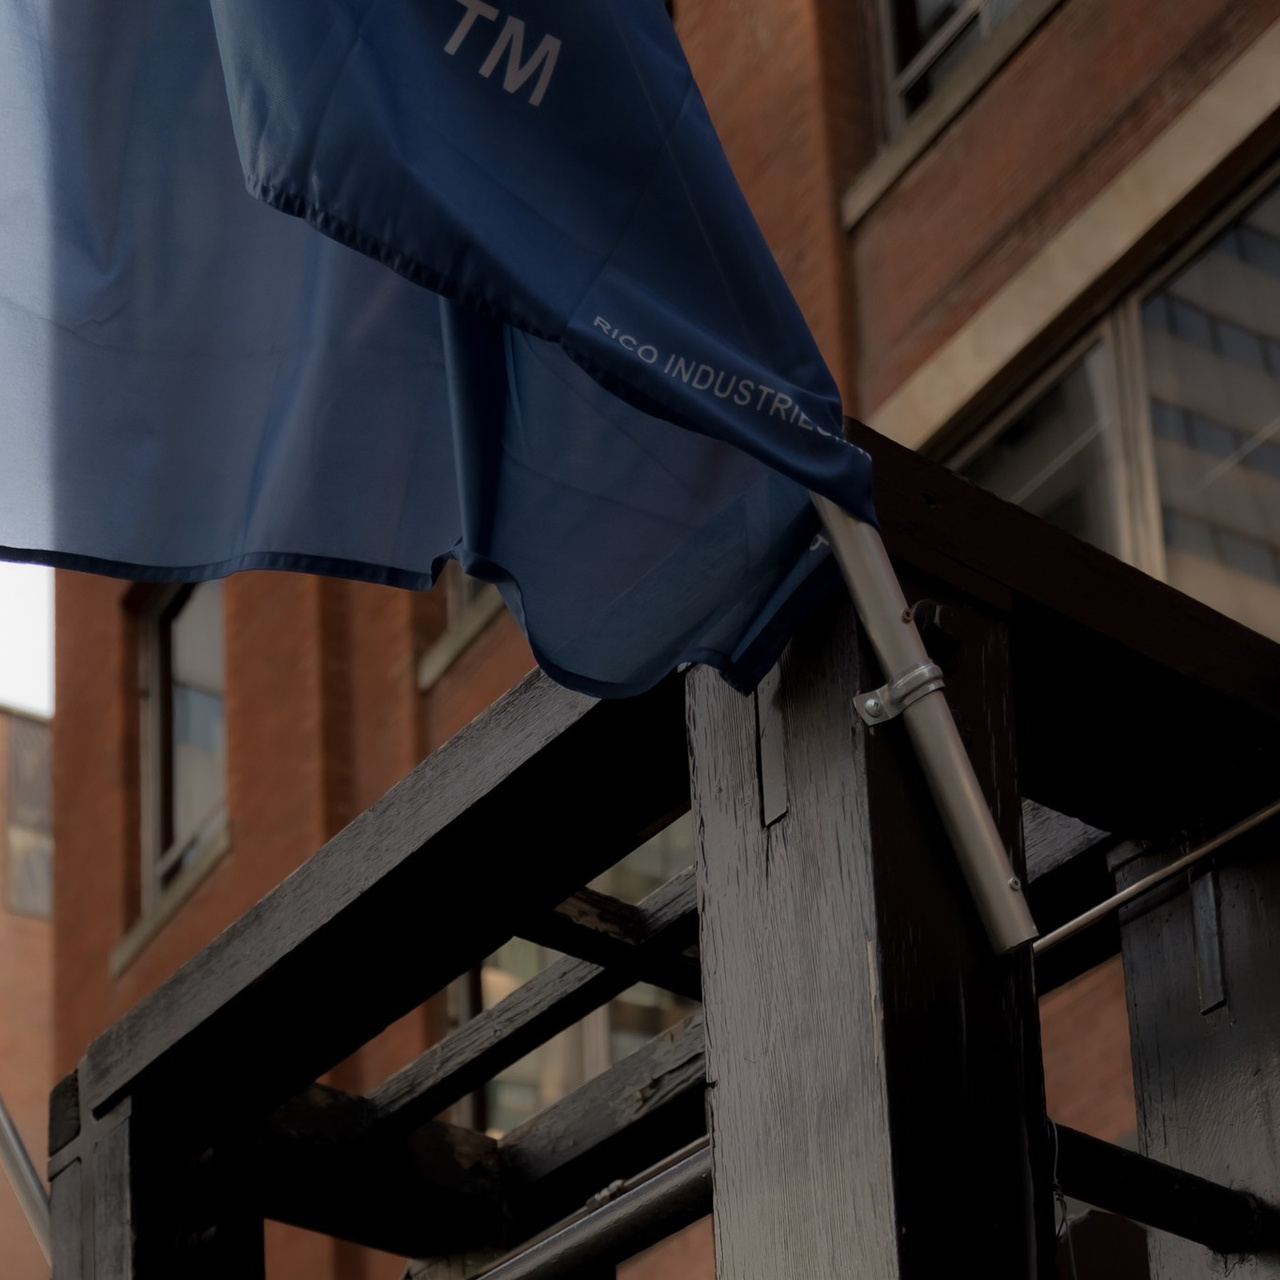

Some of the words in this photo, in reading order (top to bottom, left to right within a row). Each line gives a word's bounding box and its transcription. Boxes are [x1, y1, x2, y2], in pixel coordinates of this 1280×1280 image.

[444, 0, 562, 107] TM
[593, 315, 658, 364] RICO
[663, 354, 831, 437] INDUSTRIE
